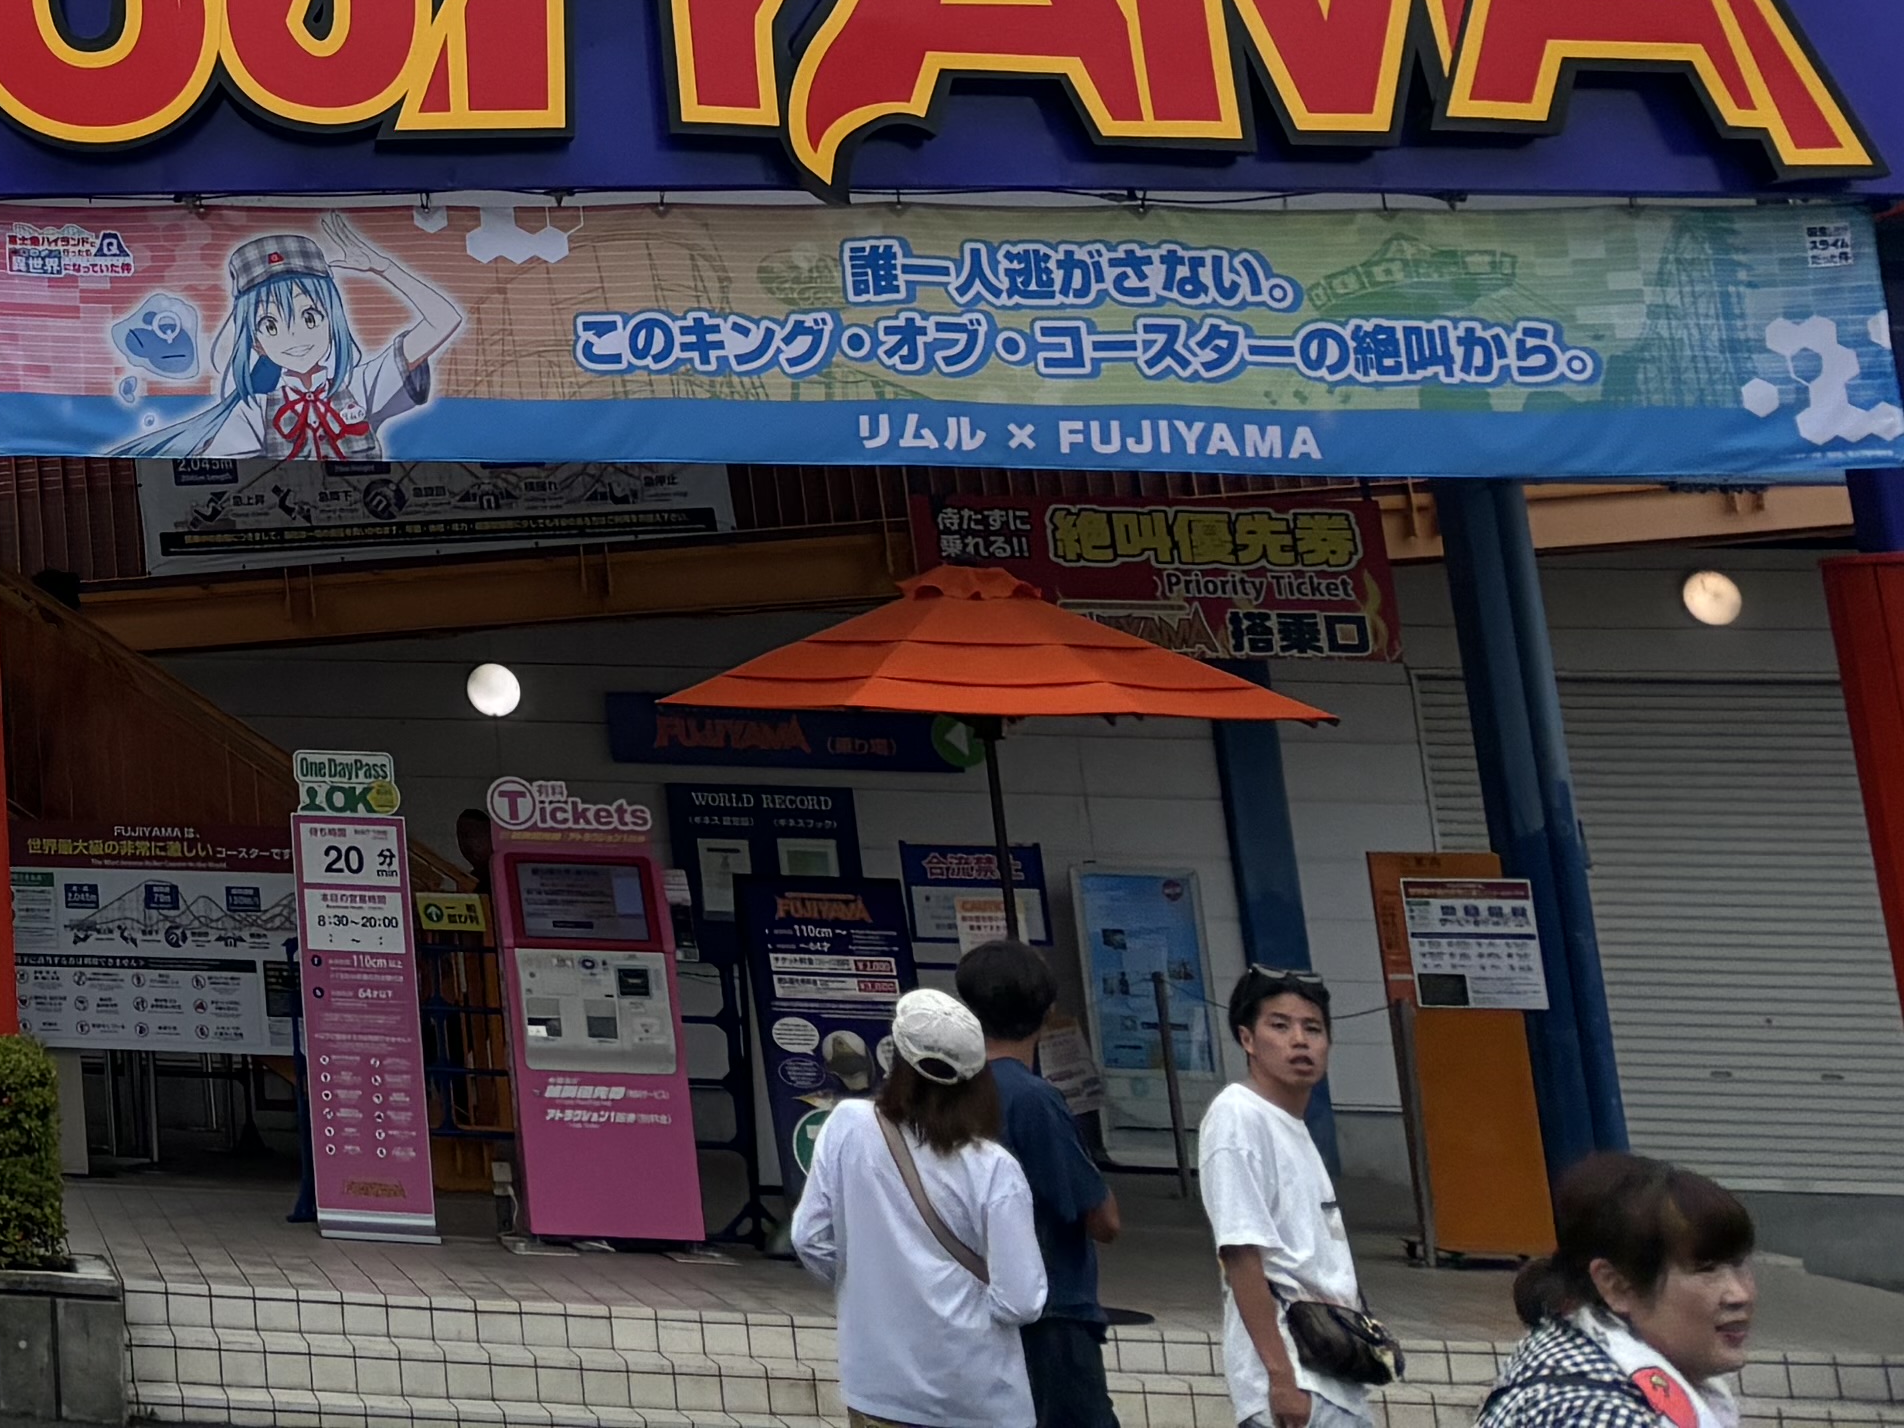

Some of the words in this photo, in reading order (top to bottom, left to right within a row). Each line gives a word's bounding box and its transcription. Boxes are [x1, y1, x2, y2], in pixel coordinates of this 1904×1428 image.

[846, 242, 1293, 311] 誰一人逃がさない。
[577, 312, 1594, 383] このキング・オブ・コースターの絶叫から。
[858, 414, 986, 451] リムル
[1058, 420, 1323, 460] FUJIYAMA
[1050, 507, 1360, 568] 絶叫優先券
[1167, 572, 1267, 602] Priority
[1270, 573, 1354, 600] Ticket
[1227, 610, 1370, 656] 搭乗口
[325, 785, 377, 813] OK
[487, 777, 651, 830] Tickets
[691, 792, 755, 808] WORLD
[762, 795, 832, 811] RECORD
[113, 826, 182, 838] FUJIYAMA
[324, 845, 364, 875] 20
[377, 848, 396, 867] 分
[775, 896, 873, 923] FUJIYAMA
[352, 954, 387, 968] 110cm
